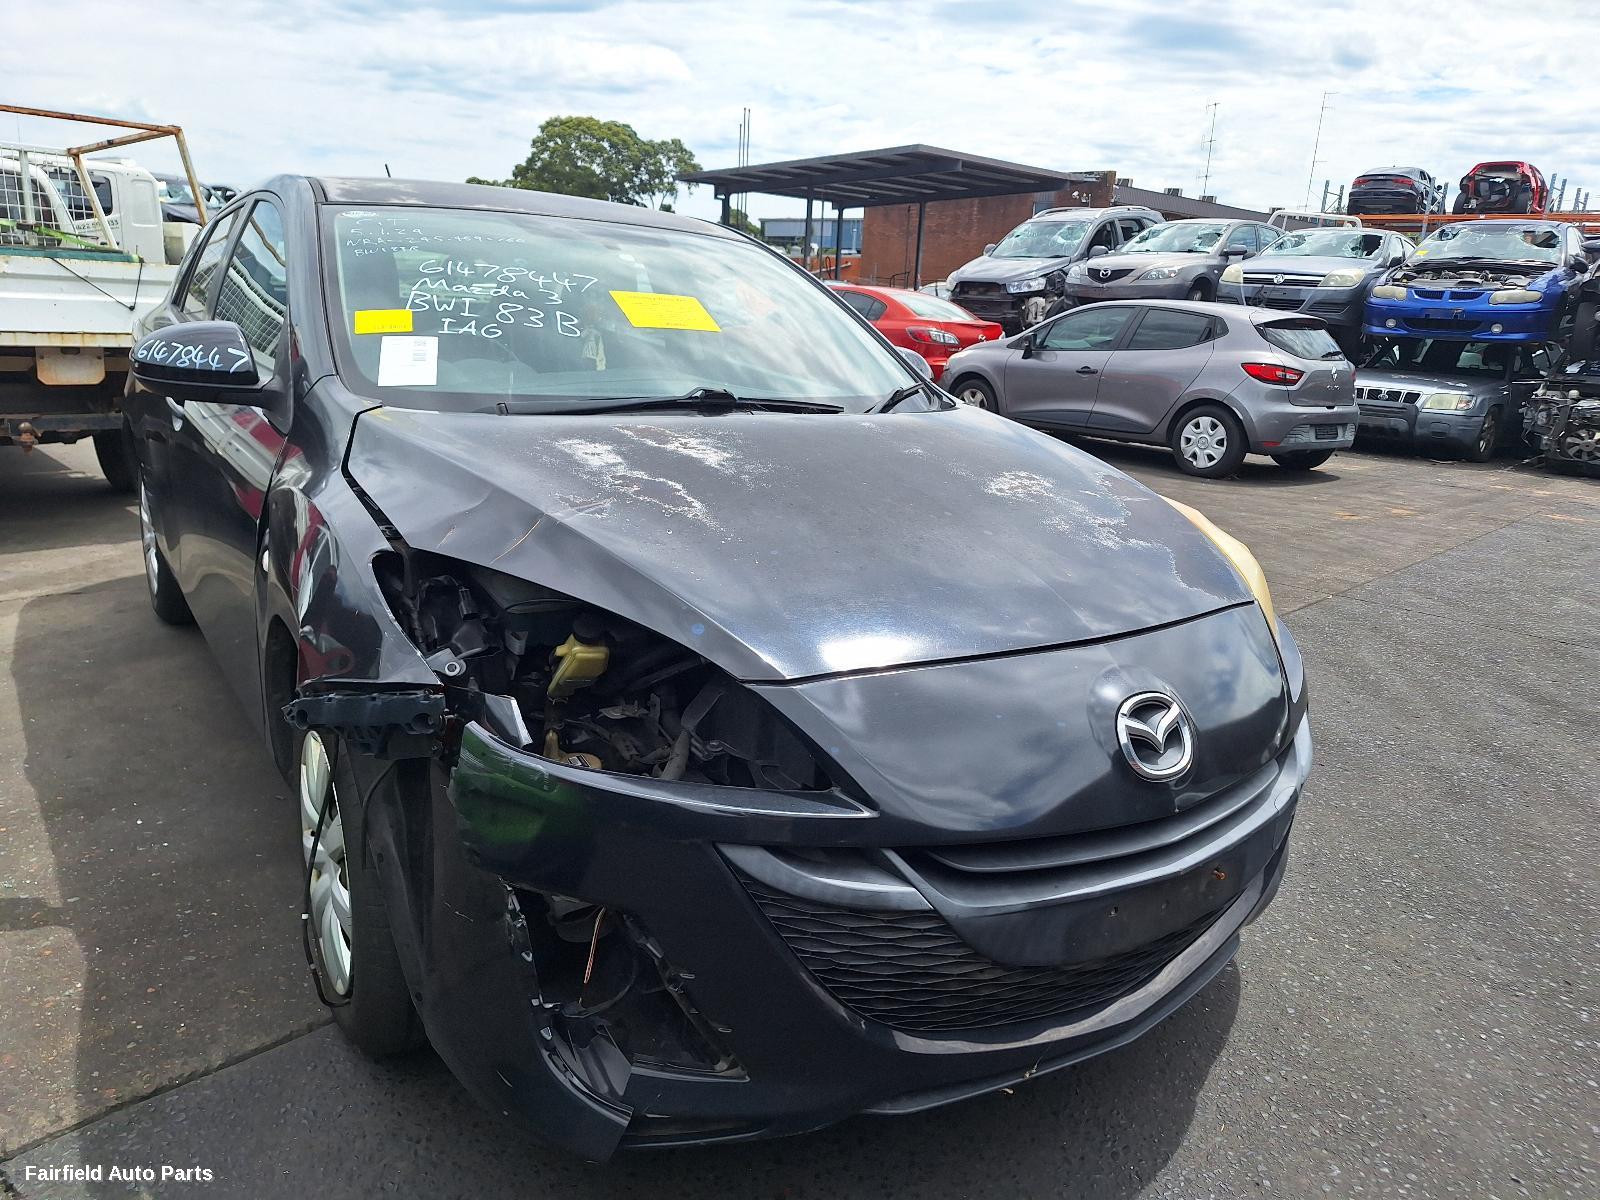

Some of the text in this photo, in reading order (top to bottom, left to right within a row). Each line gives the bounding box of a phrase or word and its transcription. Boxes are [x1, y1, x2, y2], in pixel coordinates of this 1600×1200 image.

[412, 277, 563, 305] Mazda 3
[419, 259, 599, 293] 61478447
[137, 339, 249, 374] 61478447
